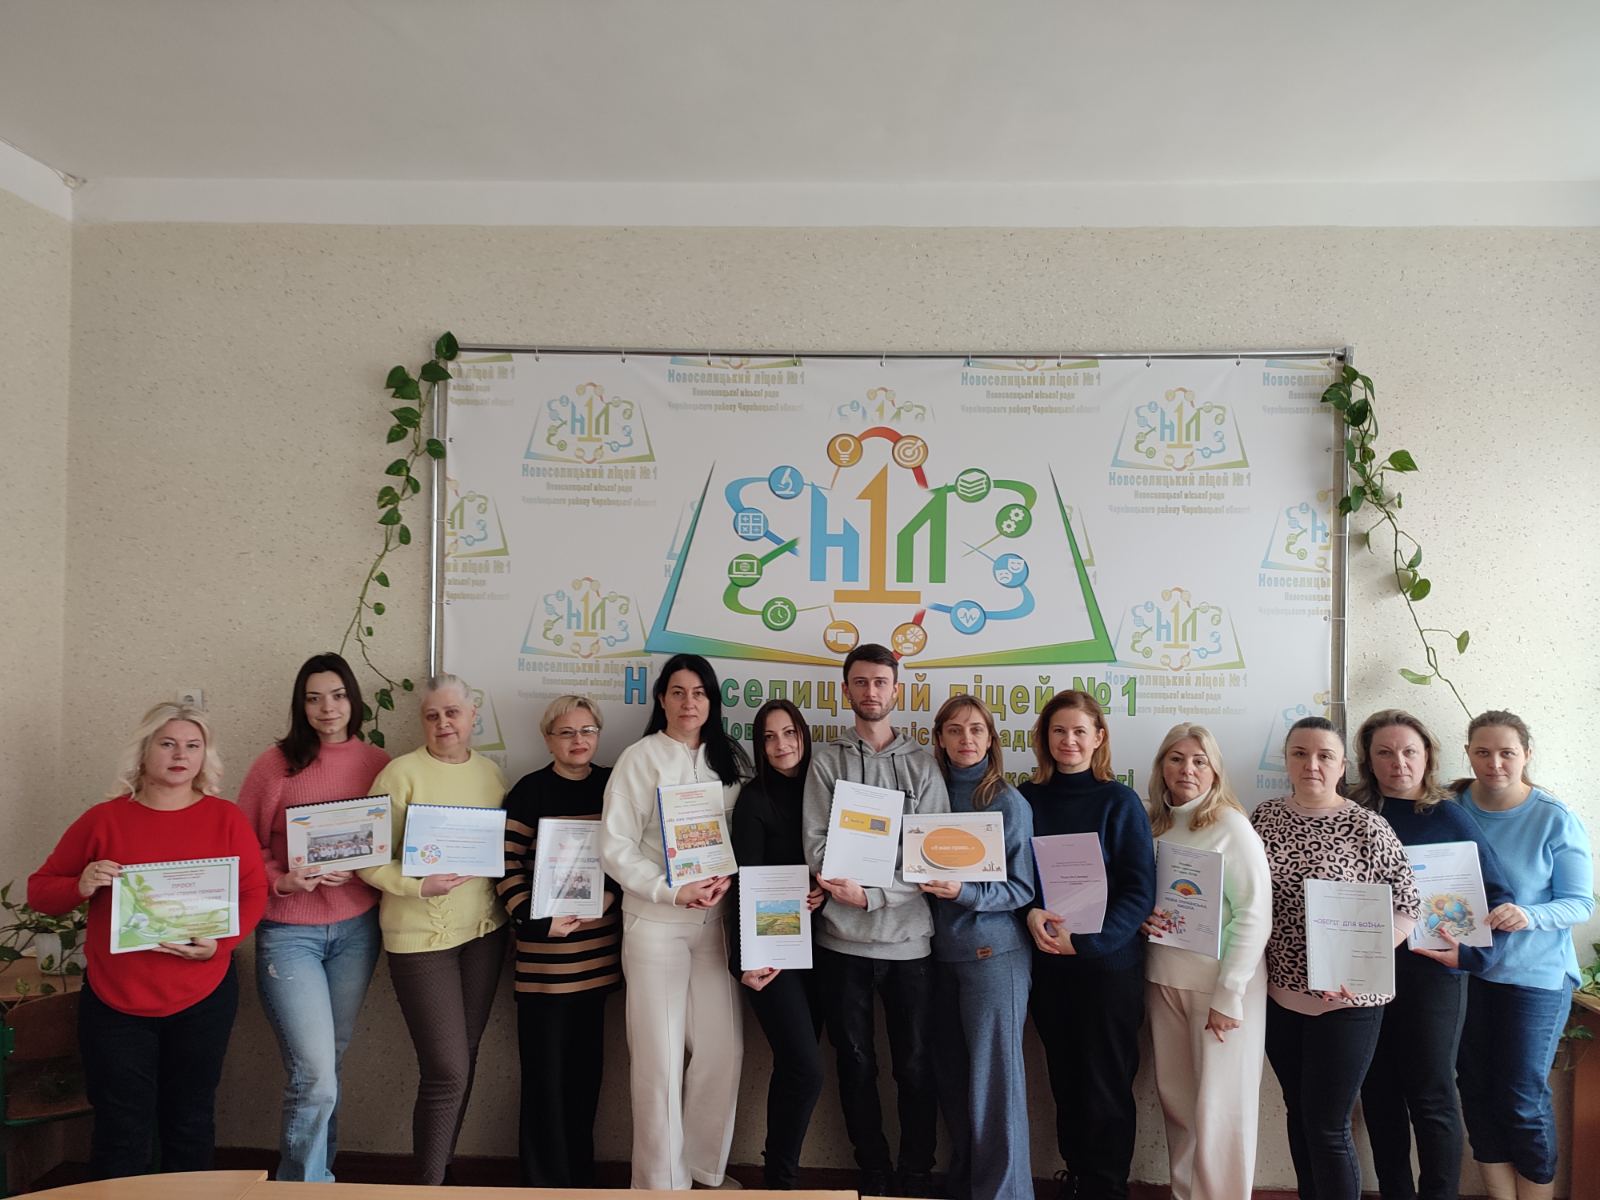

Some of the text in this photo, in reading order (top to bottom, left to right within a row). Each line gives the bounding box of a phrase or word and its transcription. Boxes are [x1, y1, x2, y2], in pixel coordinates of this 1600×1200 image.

[668, 369, 751, 386] Новоселицький
[961, 372, 1046, 388] Новоселицький
[1049, 372, 1079, 388] ліцей
[1109, 472, 1195, 489] Новоселицький
[1198, 472, 1229, 488] ліцей
[1105, 671, 1191, 688] Новелицький
[1195, 673, 1225, 689] ліцей
